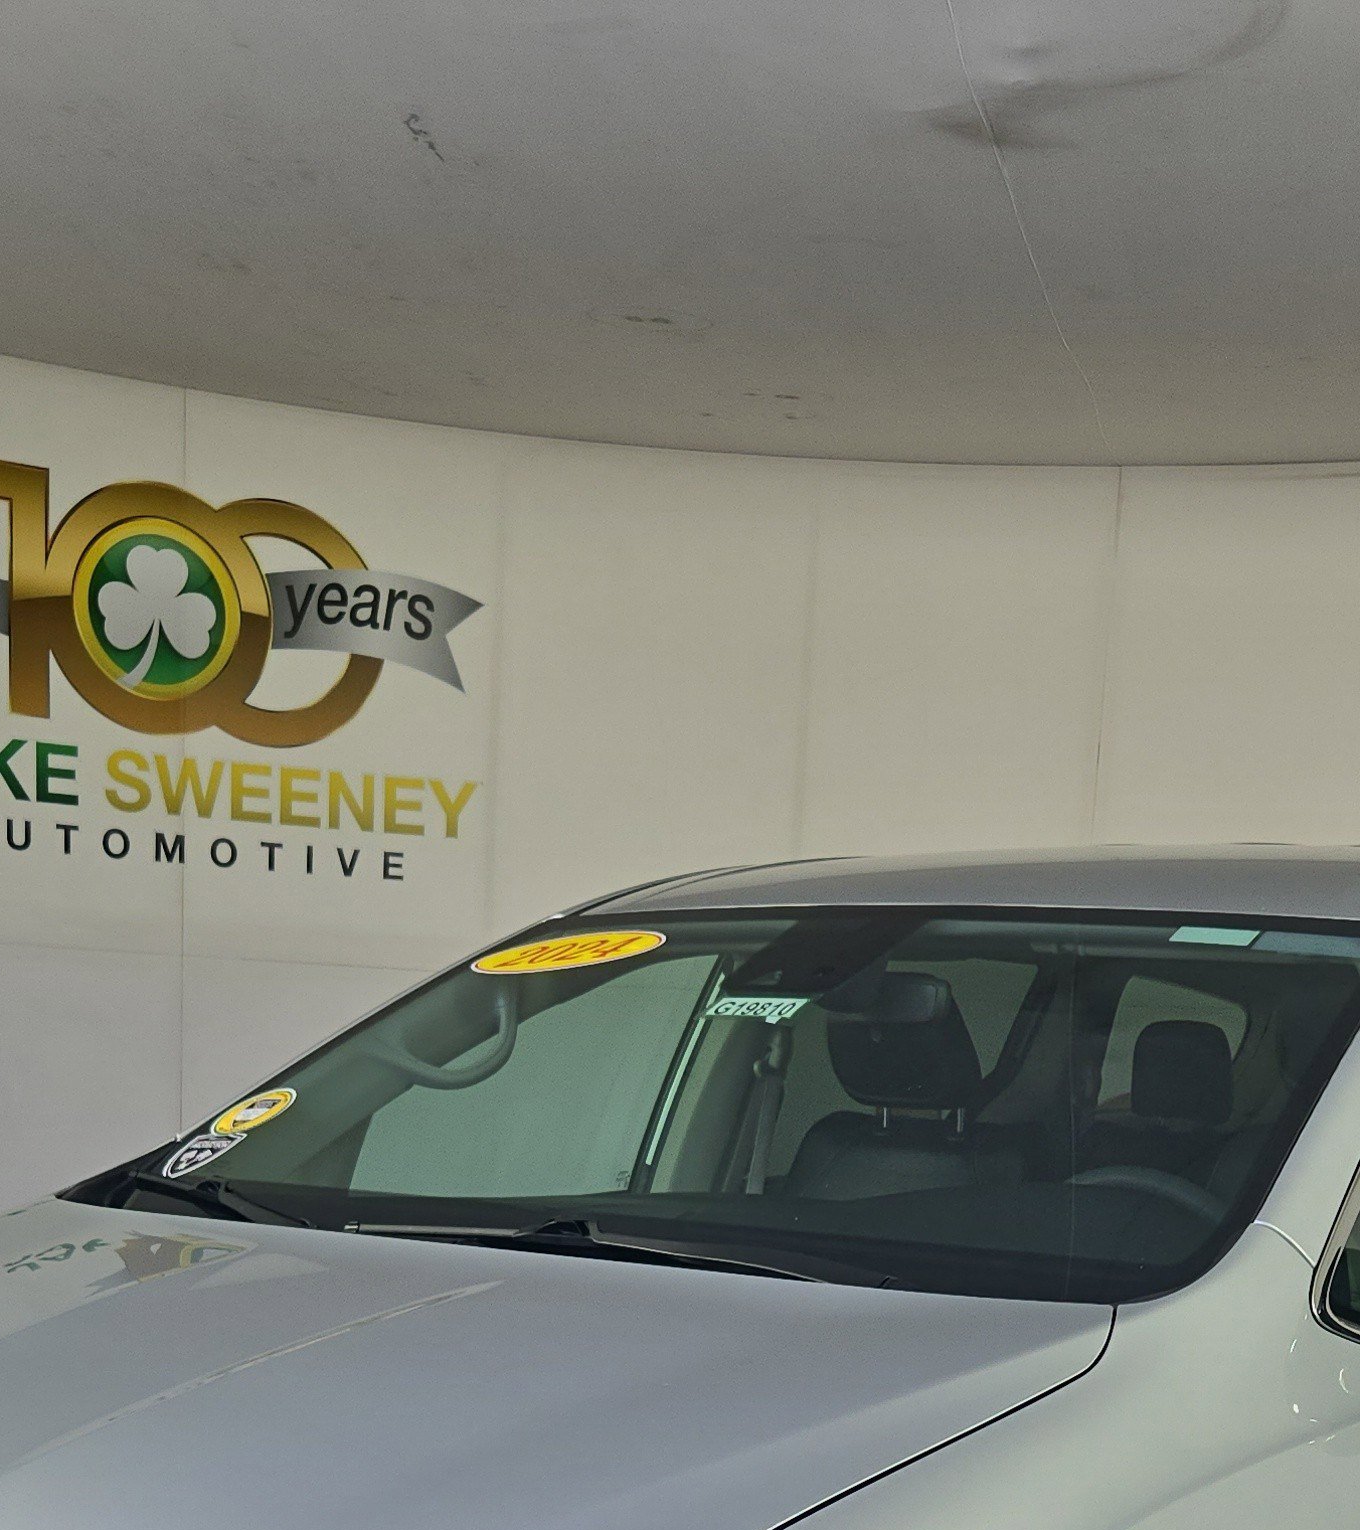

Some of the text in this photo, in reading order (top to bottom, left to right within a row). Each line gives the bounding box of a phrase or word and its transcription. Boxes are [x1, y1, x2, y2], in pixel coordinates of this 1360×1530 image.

[283, 581, 435, 641] years
[104, 749, 478, 840] SWEENEY
[493, 935, 643, 969] 2024
[713, 1001, 797, 1017] G19810
